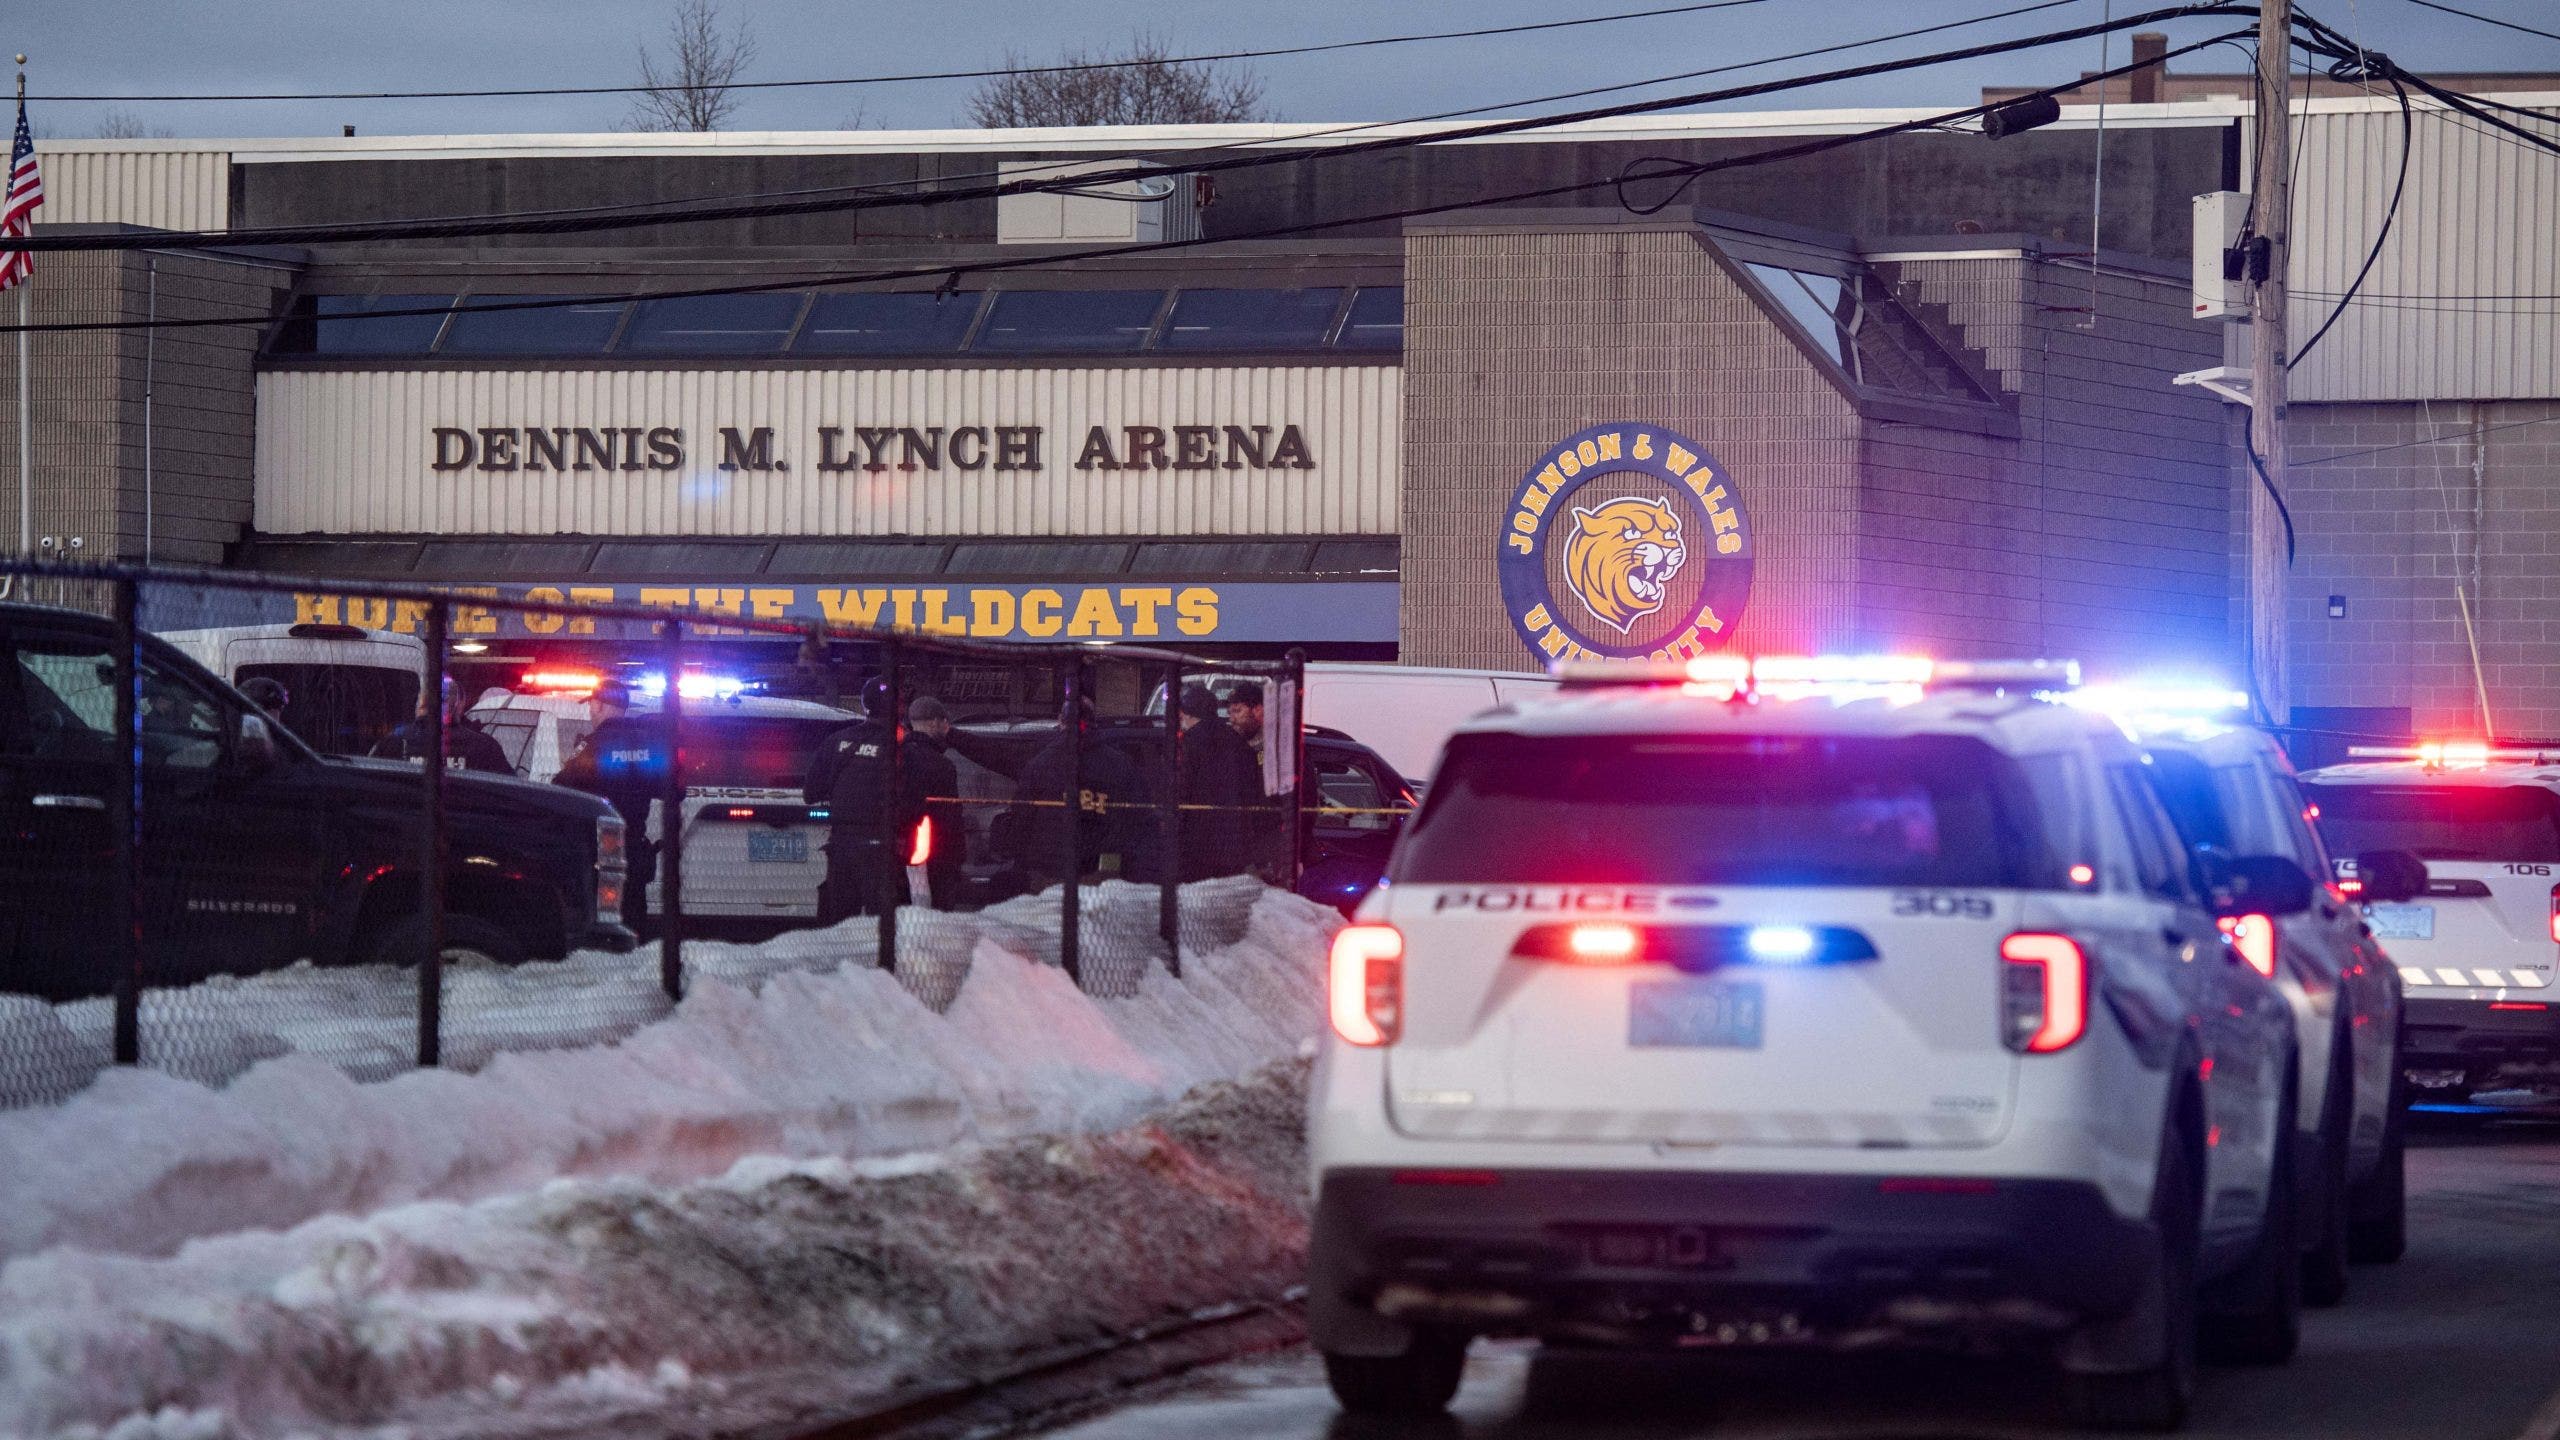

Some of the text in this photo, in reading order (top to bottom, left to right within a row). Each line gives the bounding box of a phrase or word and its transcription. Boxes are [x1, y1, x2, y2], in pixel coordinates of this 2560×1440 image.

[431, 424, 1316, 472] DENNIS M. LYNCH ARENA
[1509, 433, 1742, 555] JOHNSON & WALES
[640, 588, 794, 636] THE
[816, 587, 1219, 638] WILDCATS
[611, 749, 650, 762] POLICE
[2503, 864, 2551, 876] 106
[1434, 886, 1657, 913] POLICE
[1893, 887, 1994, 919] 309
